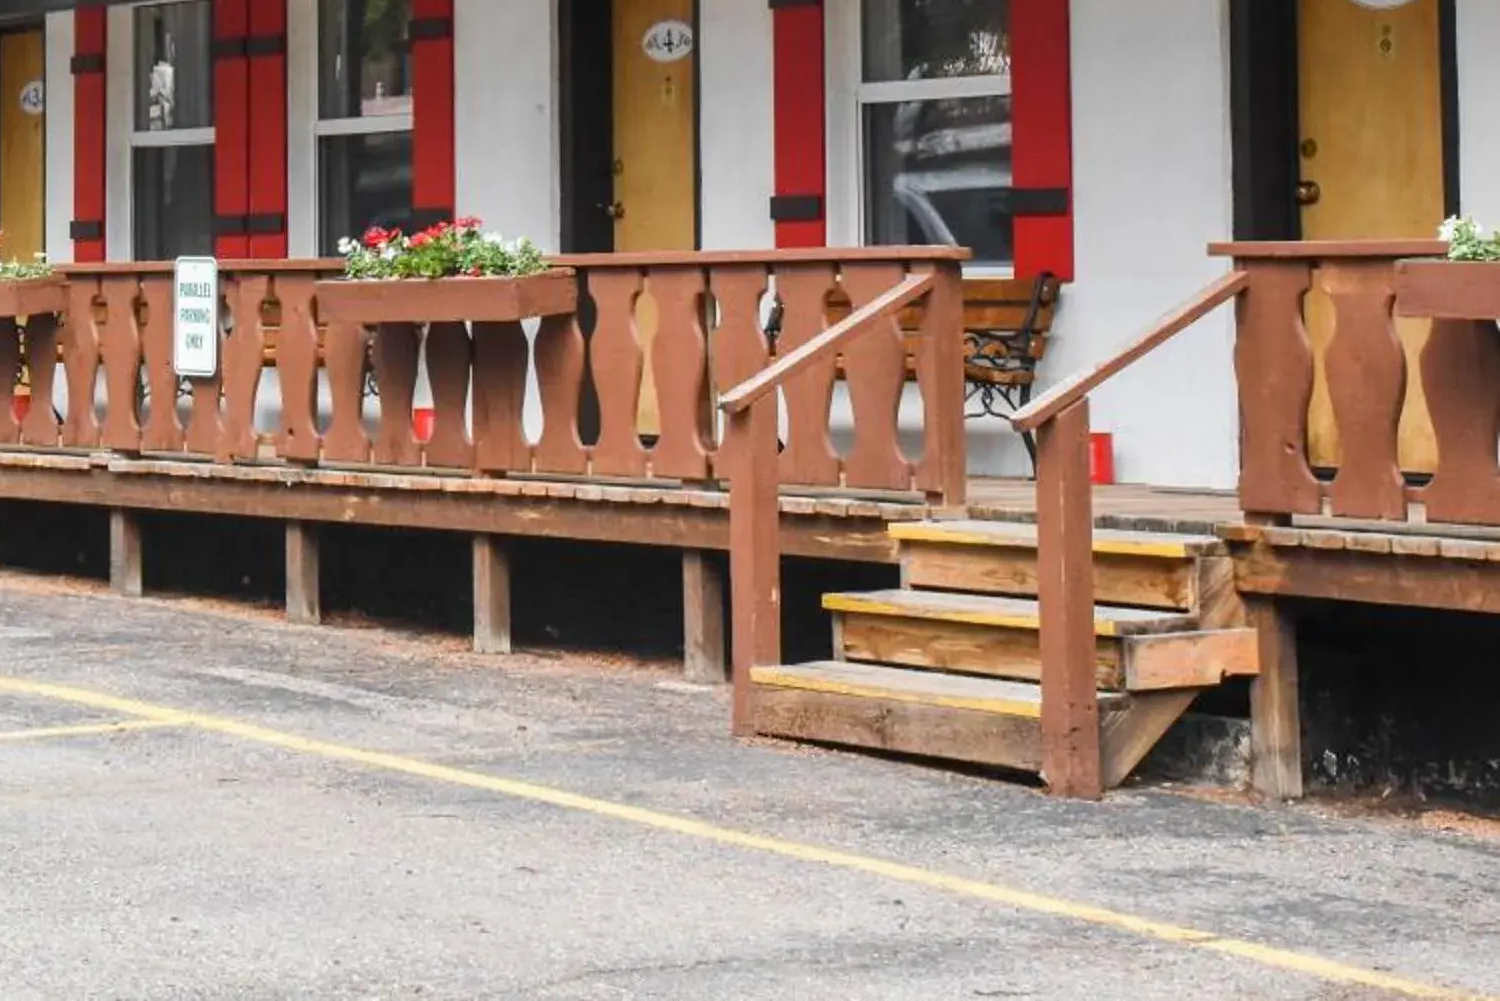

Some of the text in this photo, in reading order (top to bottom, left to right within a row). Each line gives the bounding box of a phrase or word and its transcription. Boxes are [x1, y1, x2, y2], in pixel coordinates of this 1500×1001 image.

[662, 28, 674, 53] 4
[179, 282, 211, 298] PARALLEL
[179, 307, 210, 324] PARKING
[185, 332, 203, 350] ONLY
